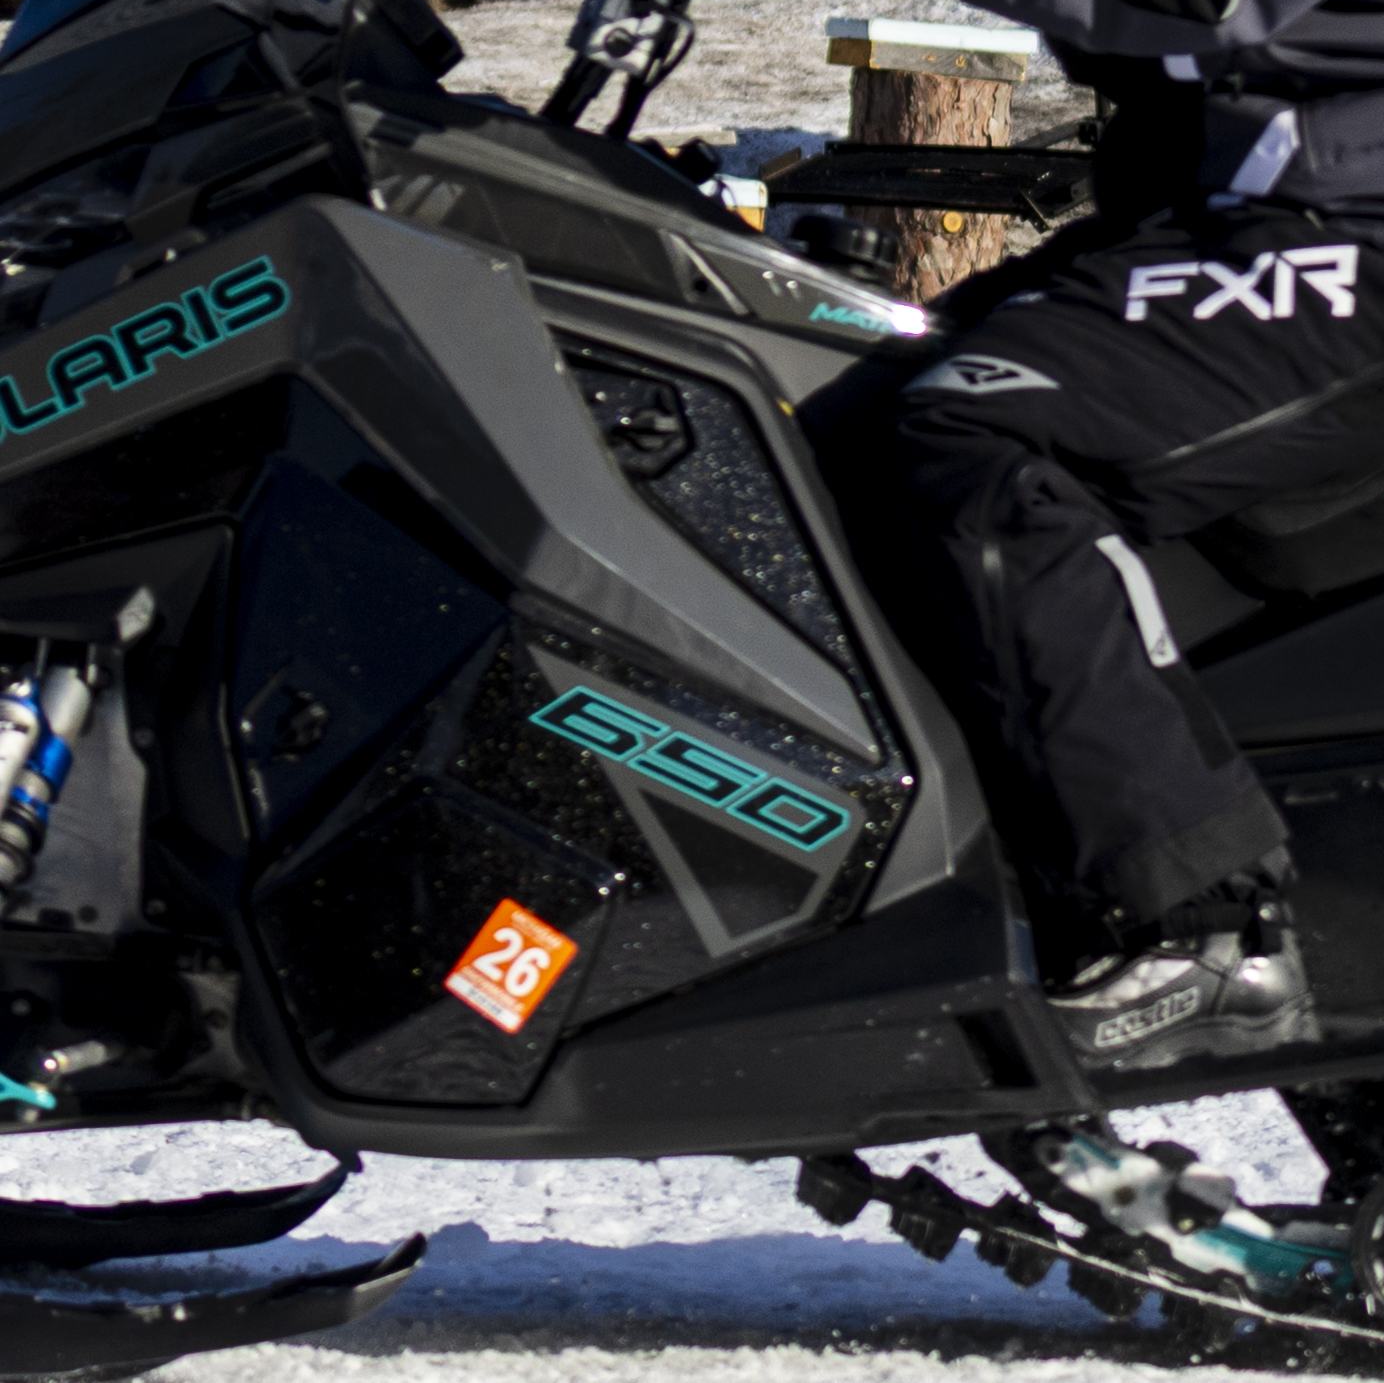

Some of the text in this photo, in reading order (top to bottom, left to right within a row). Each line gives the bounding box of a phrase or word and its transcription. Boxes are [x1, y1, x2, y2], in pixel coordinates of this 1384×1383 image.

[1125, 244, 1359, 322] FXR
[0, 256, 291, 442] LARIS
[528, 685, 852, 853] 650
[475, 927, 553, 999] 26
